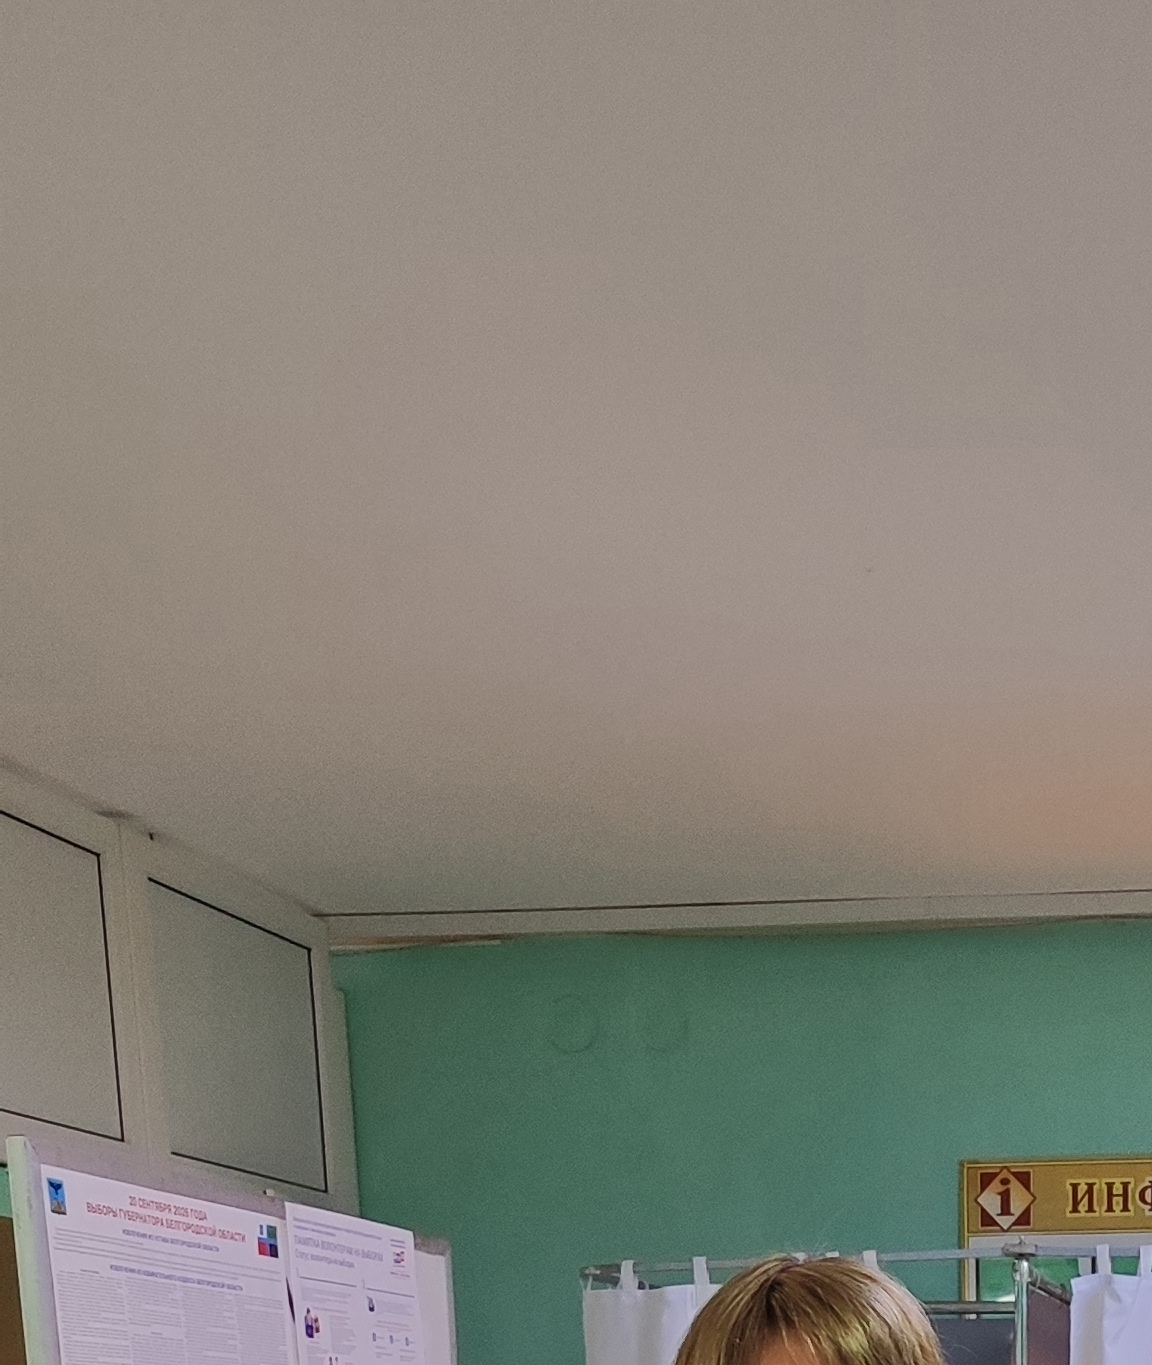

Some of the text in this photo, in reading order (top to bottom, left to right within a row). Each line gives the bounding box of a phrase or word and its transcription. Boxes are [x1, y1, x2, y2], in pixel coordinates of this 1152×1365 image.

[86, 1202, 118, 1218] ВЫБОРЫ
[119, 1209, 165, 1228] ГУБЕРНАТОРА
[166, 1217, 217, 1238] БЕЛГОРОДСКОЙ
[217, 1229, 247, 1243] ОБЛАСТИ
[138, 1197, 172, 1214] СЕНТЯБРЯ
[190, 1208, 208, 1222] ГОДА
